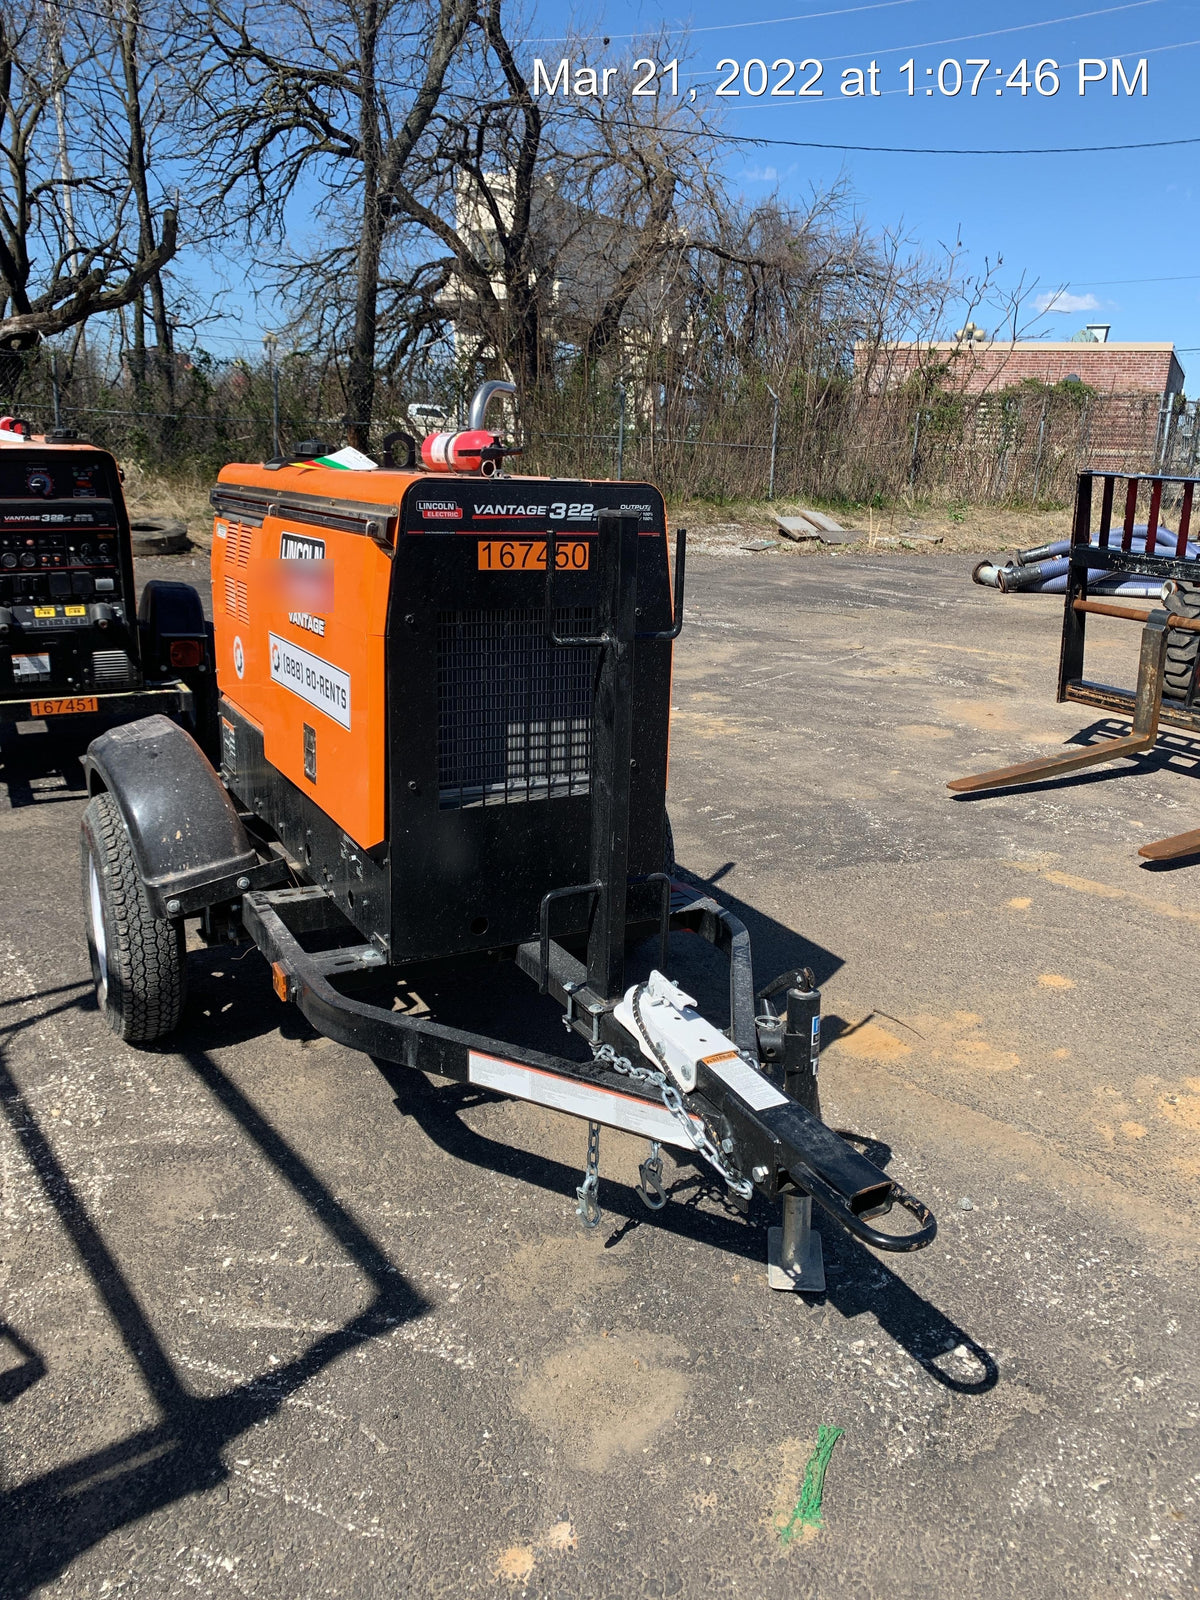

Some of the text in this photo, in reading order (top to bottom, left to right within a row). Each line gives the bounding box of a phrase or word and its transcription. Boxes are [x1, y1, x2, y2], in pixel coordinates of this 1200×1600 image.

[418, 502, 455, 510] LINCOLN
[427, 510, 459, 518] ELECTRIC
[473, 503, 594, 520] VANTAGE 322
[288, 611, 325, 638] VANTAGE
[283, 653, 304, 684] (888)
[306, 667, 347, 710] 80-RENTS
[33, 698, 95, 715] 167451
